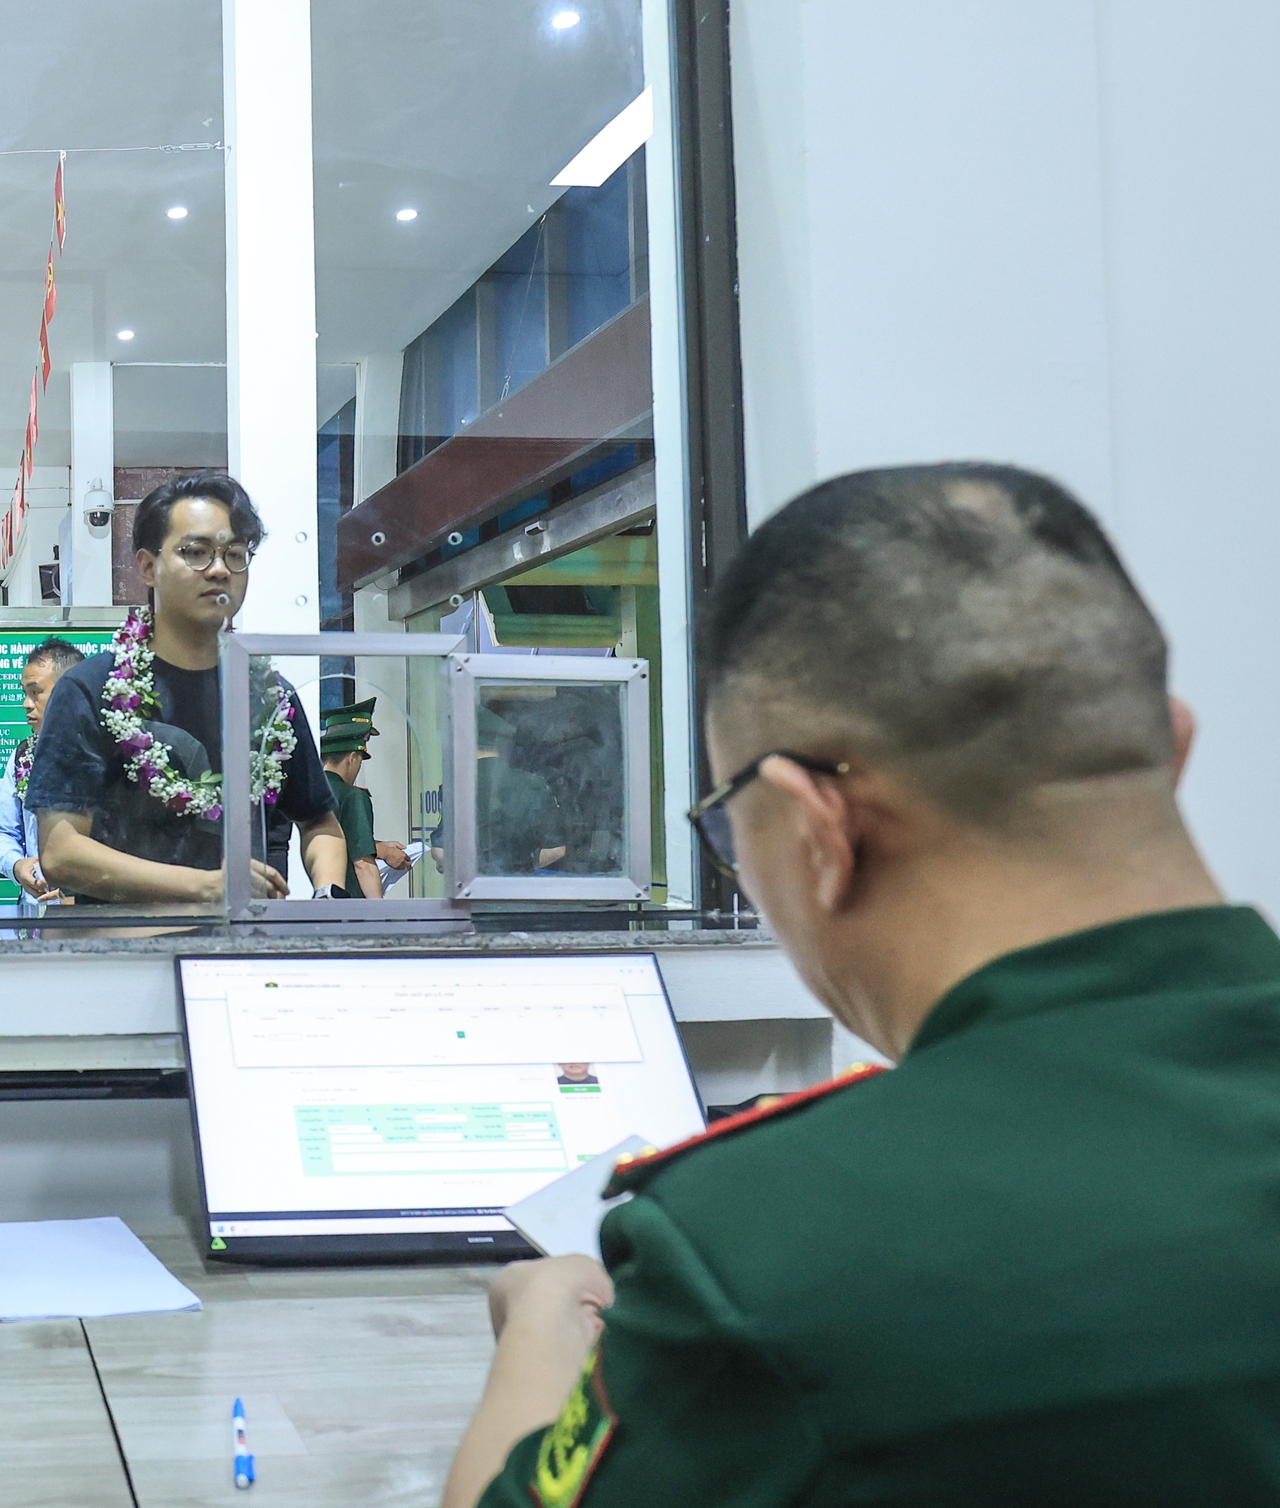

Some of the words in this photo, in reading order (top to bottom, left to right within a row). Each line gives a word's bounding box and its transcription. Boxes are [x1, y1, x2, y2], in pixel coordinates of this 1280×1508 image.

[10, 642, 36, 654] HÀNH
[71, 642, 98, 656] UỘC
[100, 644, 112, 654] PH
[12, 655, 23, 668] VỀ
[420, 790, 442, 814] 00
